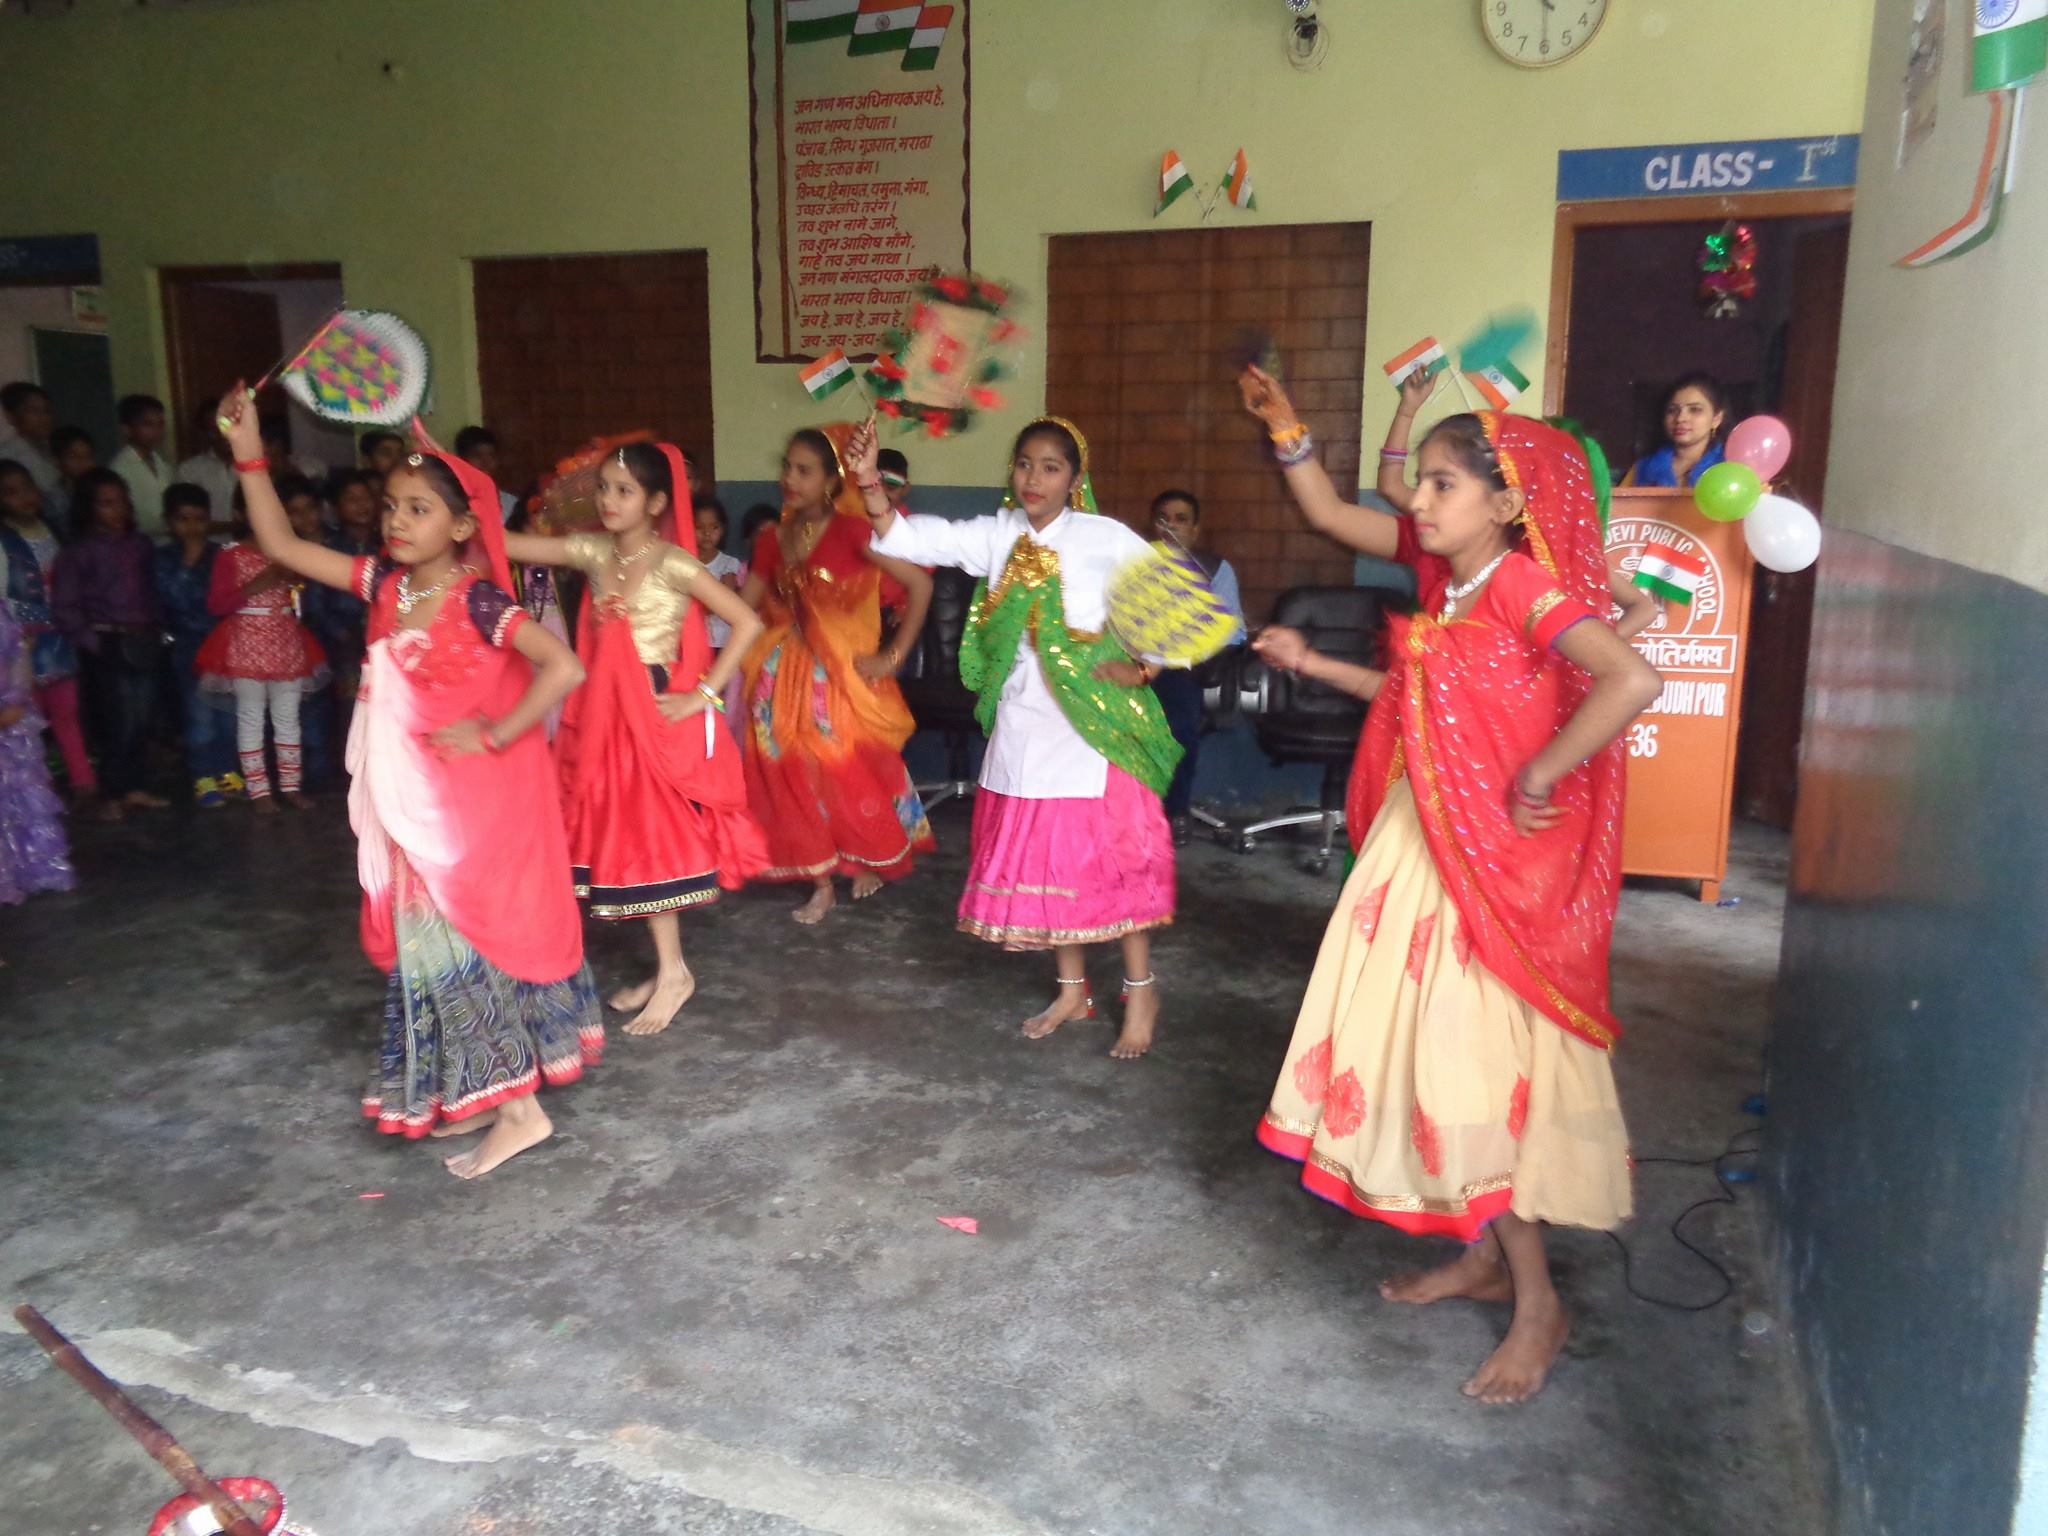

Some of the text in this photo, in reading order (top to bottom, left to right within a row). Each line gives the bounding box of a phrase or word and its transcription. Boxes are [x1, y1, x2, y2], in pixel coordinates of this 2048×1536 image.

[1496, 1, 1506, 17] 9
[1577, 12, 1588, 27] 4
[1503, 22, 1513, 37] 8
[1561, 29, 1572, 46] 5
[1518, 35, 1529, 52] 7
[1539, 39, 1550, 55] 6
[794, 100, 813, 114] जन
[815, 98, 834, 113] गण
[836, 96, 855, 110] मन
[795, 121, 823, 137] भारत
[824, 118, 852, 134] भाग्य
[899, 135, 933, 150] मराठा
[797, 220, 816, 233] तव
[817, 219, 840, 235] शुभ
[843, 216, 868, 231] नामे
[798, 239, 816, 253] तव
[816, 238, 841, 253] शुभ
[841, 233, 884, 250] आशिष
[824, 255, 845, 268] तव
[845, 253, 869, 267] जय
[798, 271, 817, 286] जन
[818, 271, 839, 285] गण
[801, 293, 830, 307] भारत
[833, 291, 866, 306] भाग्य
[800, 315, 821, 329] जय
[833, 313, 854, 327] जय
[868, 312, 892, 326] जय
